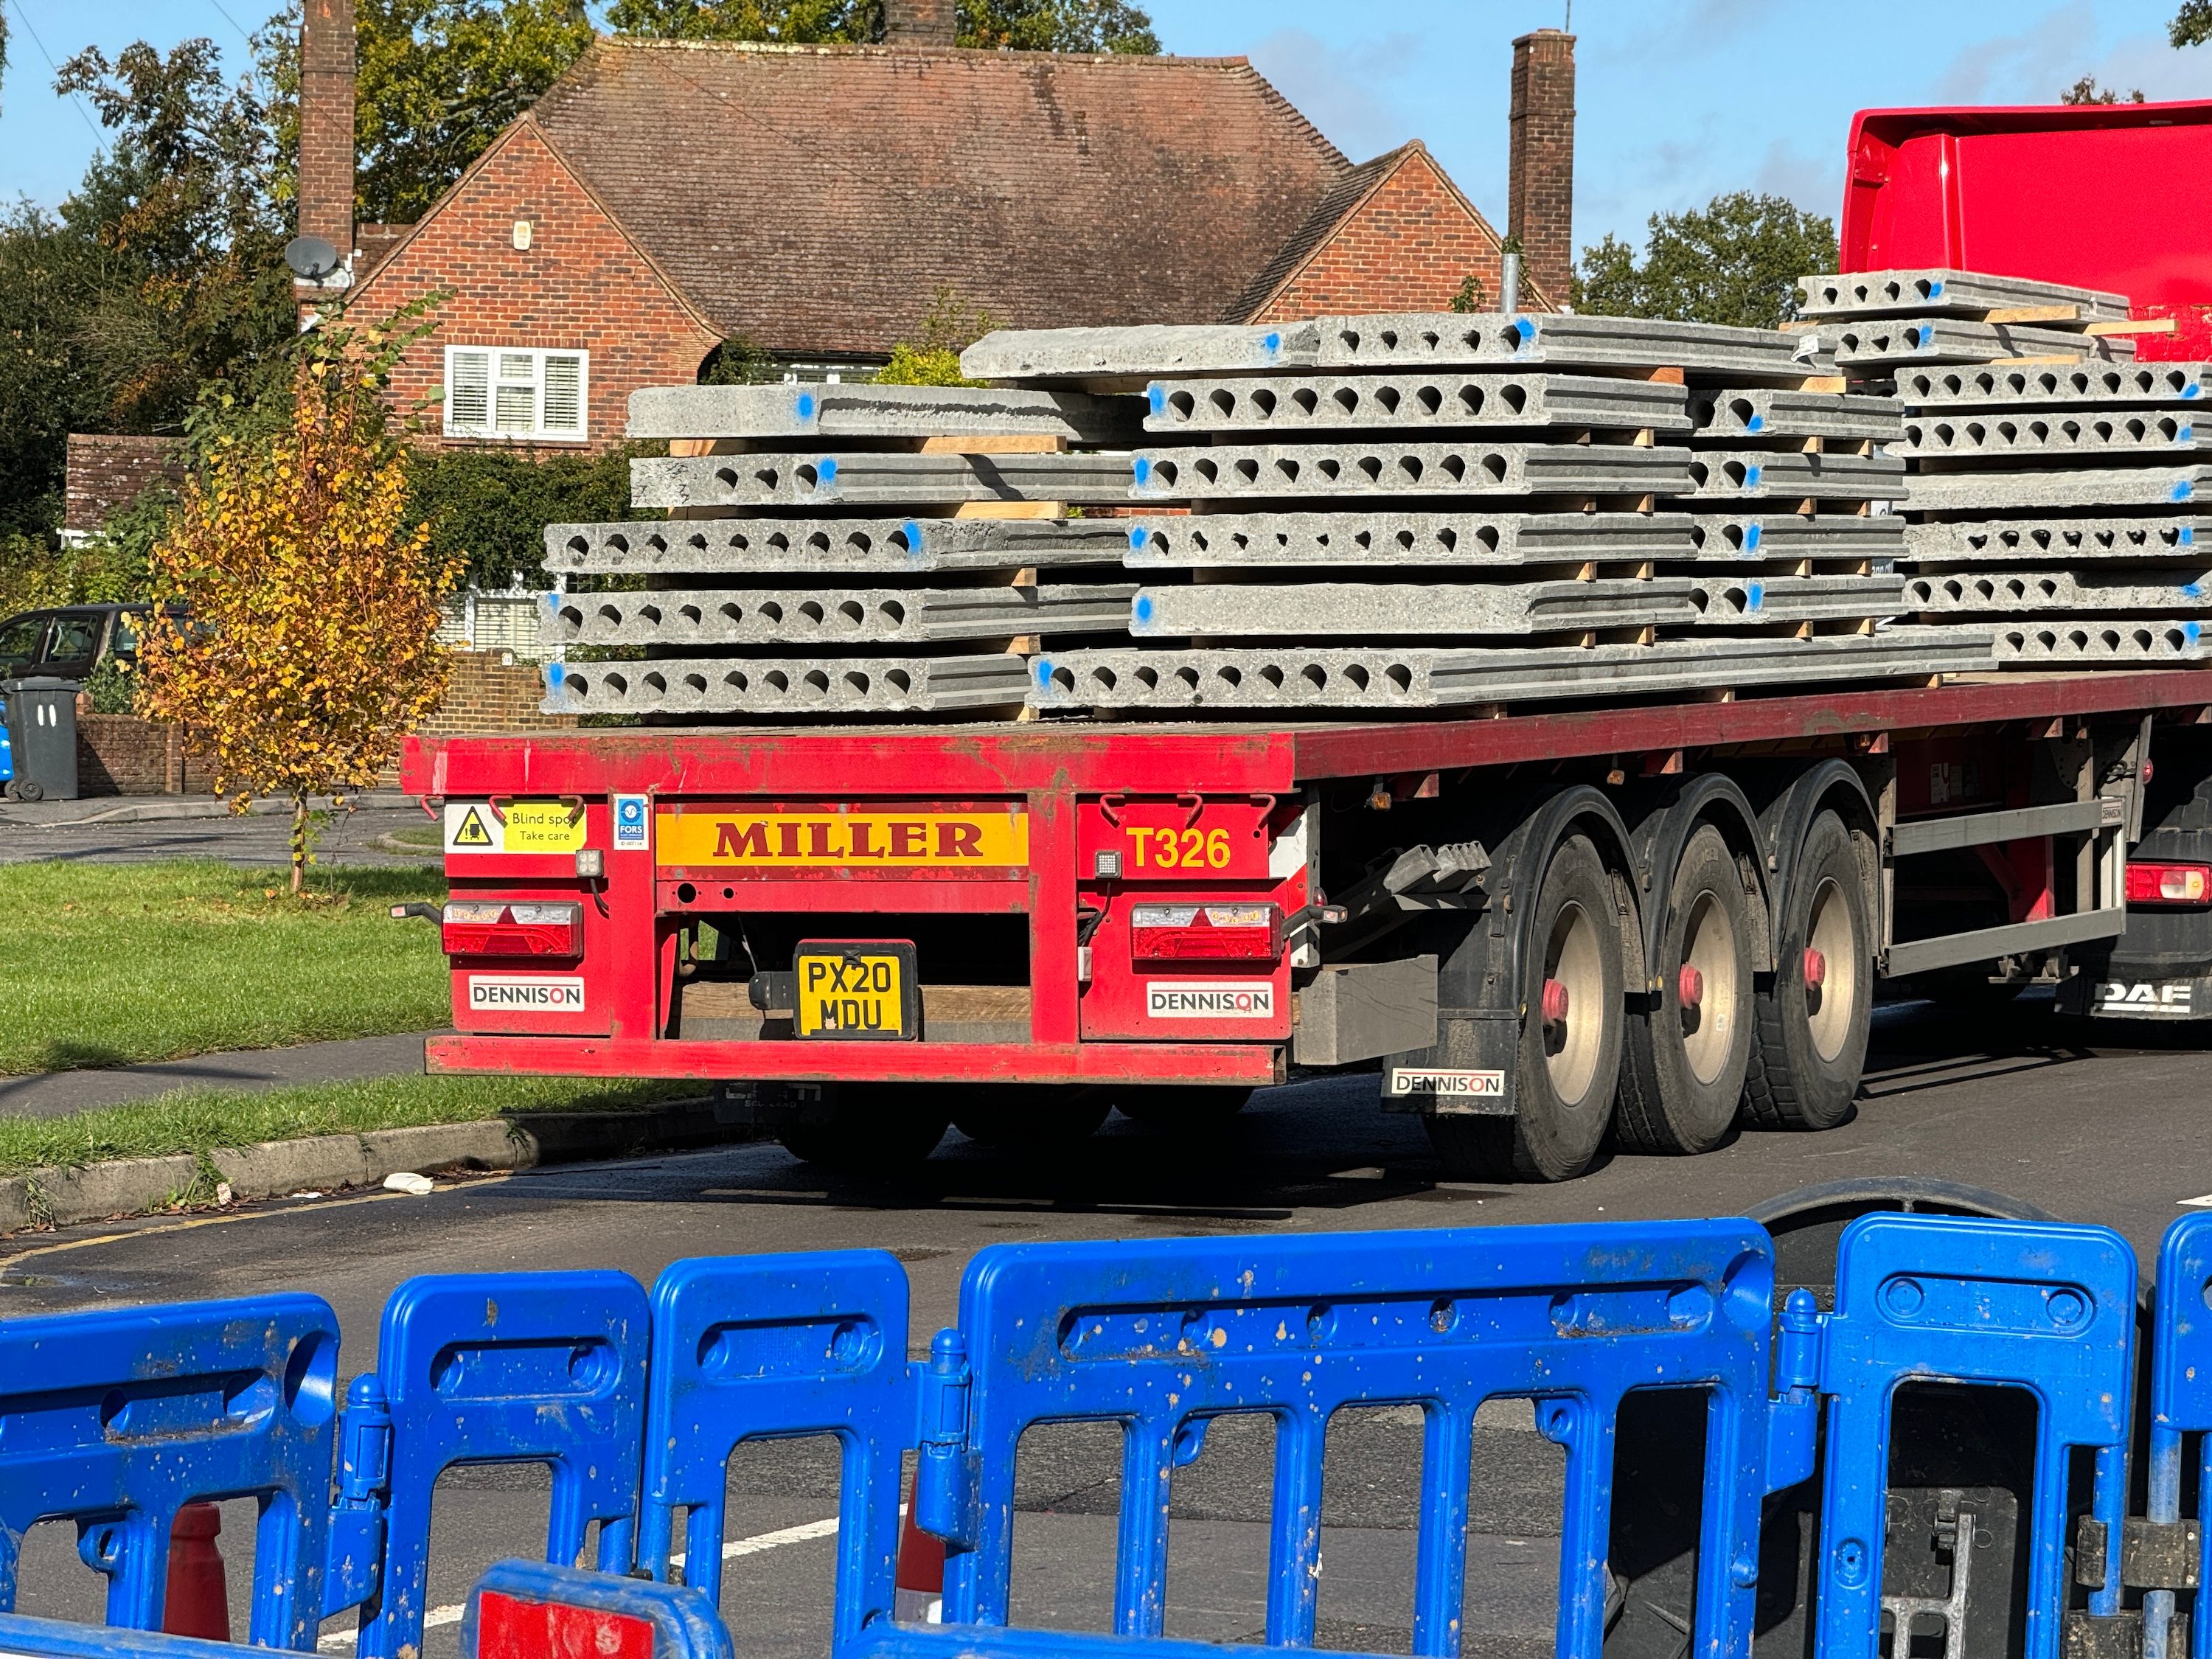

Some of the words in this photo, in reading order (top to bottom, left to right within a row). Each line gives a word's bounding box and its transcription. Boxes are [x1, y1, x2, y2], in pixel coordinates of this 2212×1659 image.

[512, 813, 544, 824] Blind
[520, 830, 544, 841] Take
[620, 825, 642, 834] FORS
[712, 822, 984, 858] MILLER
[1126, 827, 1231, 869] T326
[808, 961, 891, 993] PX20
[473, 987, 580, 1004] DENNISON
[1152, 993, 1269, 1010] DENNISON
[2095, 983, 2191, 1003] DAF
[820, 999, 882, 1029] MDU
[1397, 1076, 1499, 1093] DENNISON
[745, 1099, 797, 1108] SCLAND
